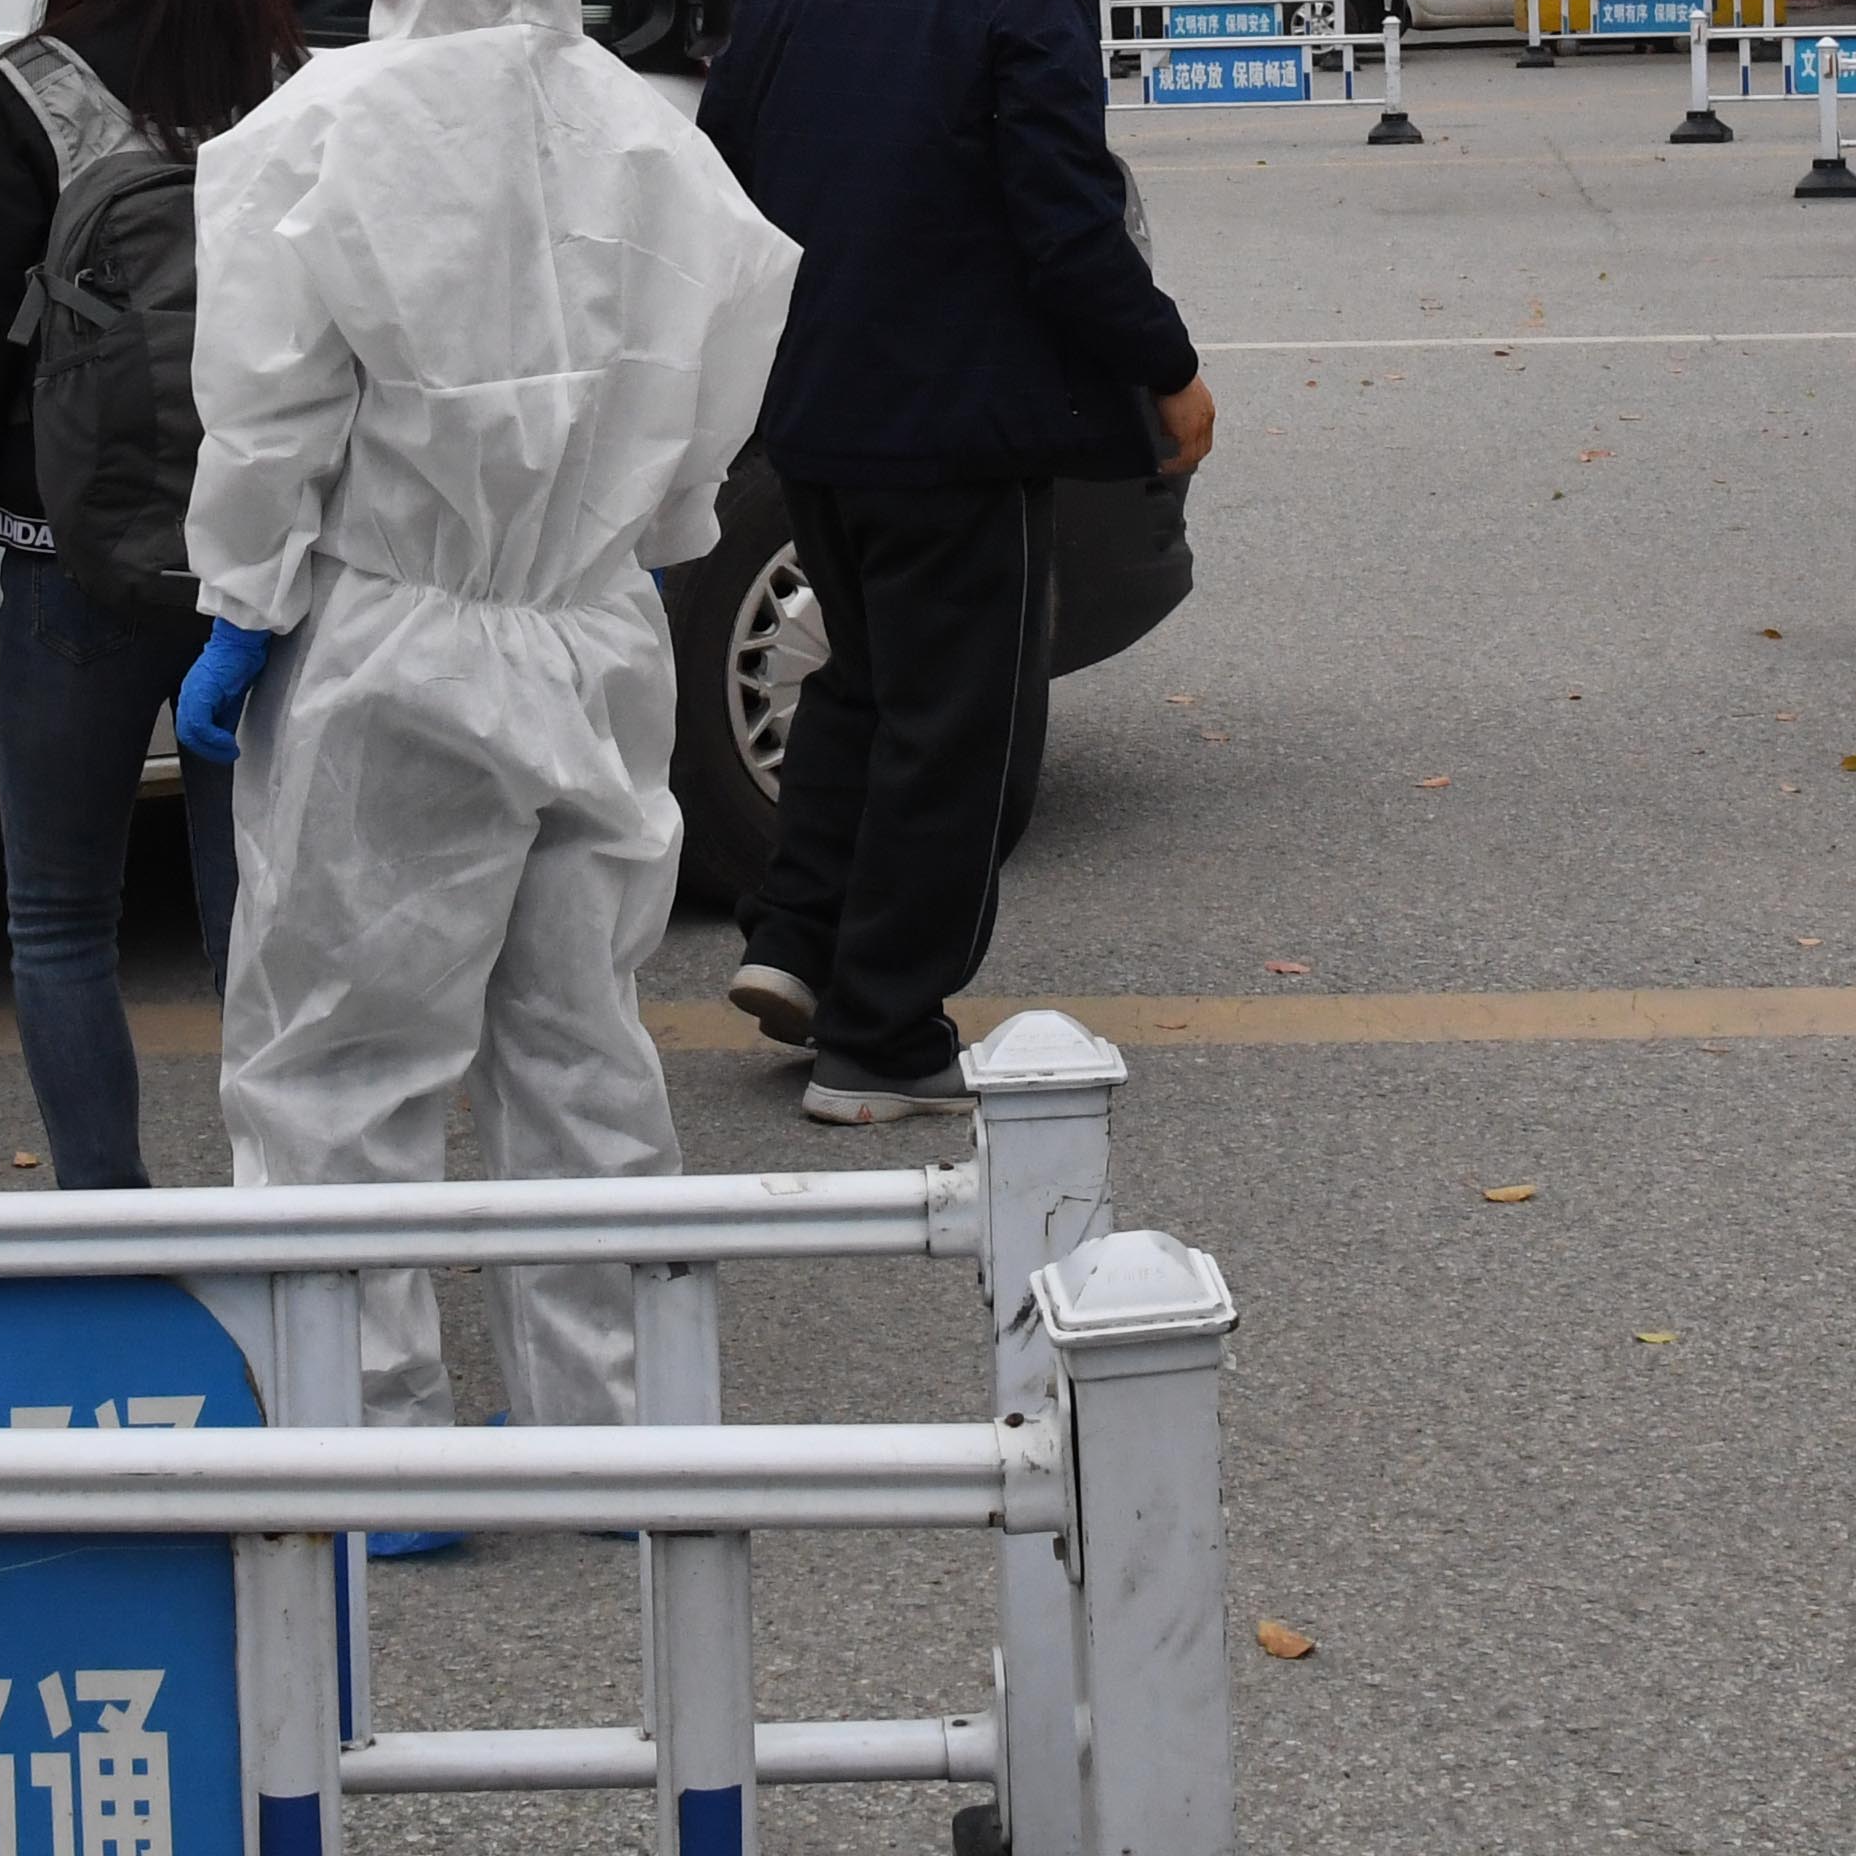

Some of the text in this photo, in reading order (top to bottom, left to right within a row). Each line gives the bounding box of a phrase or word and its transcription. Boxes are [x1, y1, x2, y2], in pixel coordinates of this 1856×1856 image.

[1174, 12, 1271, 34] 文明有序 保障安全
[1603, 3, 1649, 24] 文明有序
[1159, 59, 1297, 90] 规范停放 保障畅通
